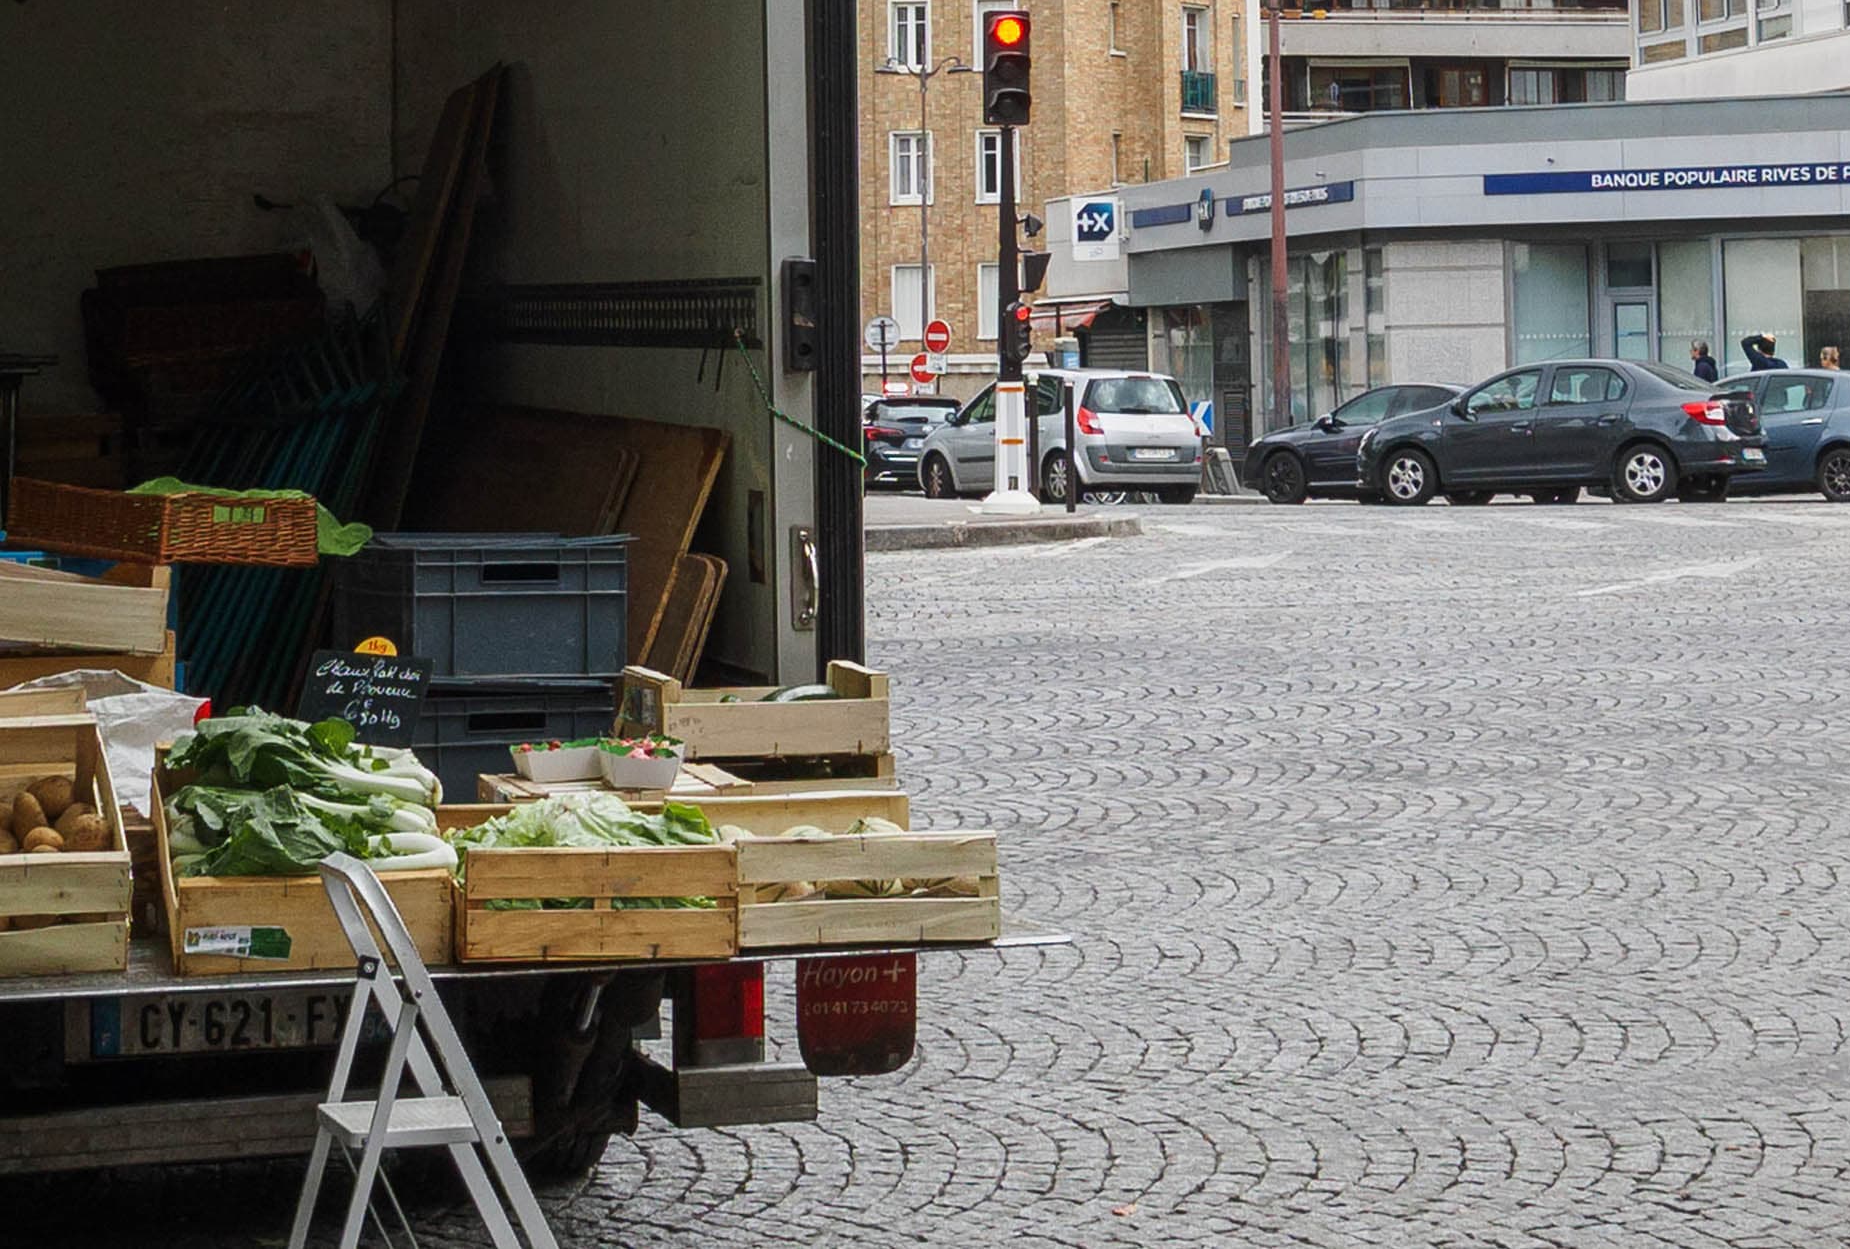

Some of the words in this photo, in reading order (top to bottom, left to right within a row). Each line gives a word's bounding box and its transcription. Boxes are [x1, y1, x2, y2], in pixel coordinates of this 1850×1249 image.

[1591, 173, 1660, 188] BANQUE
[1664, 169, 1758, 185] POPULAIRE
[1761, 166, 1811, 182] RIVES
[1815, 166, 1838, 180] DE
[802, 957, 877, 989] Hayon
